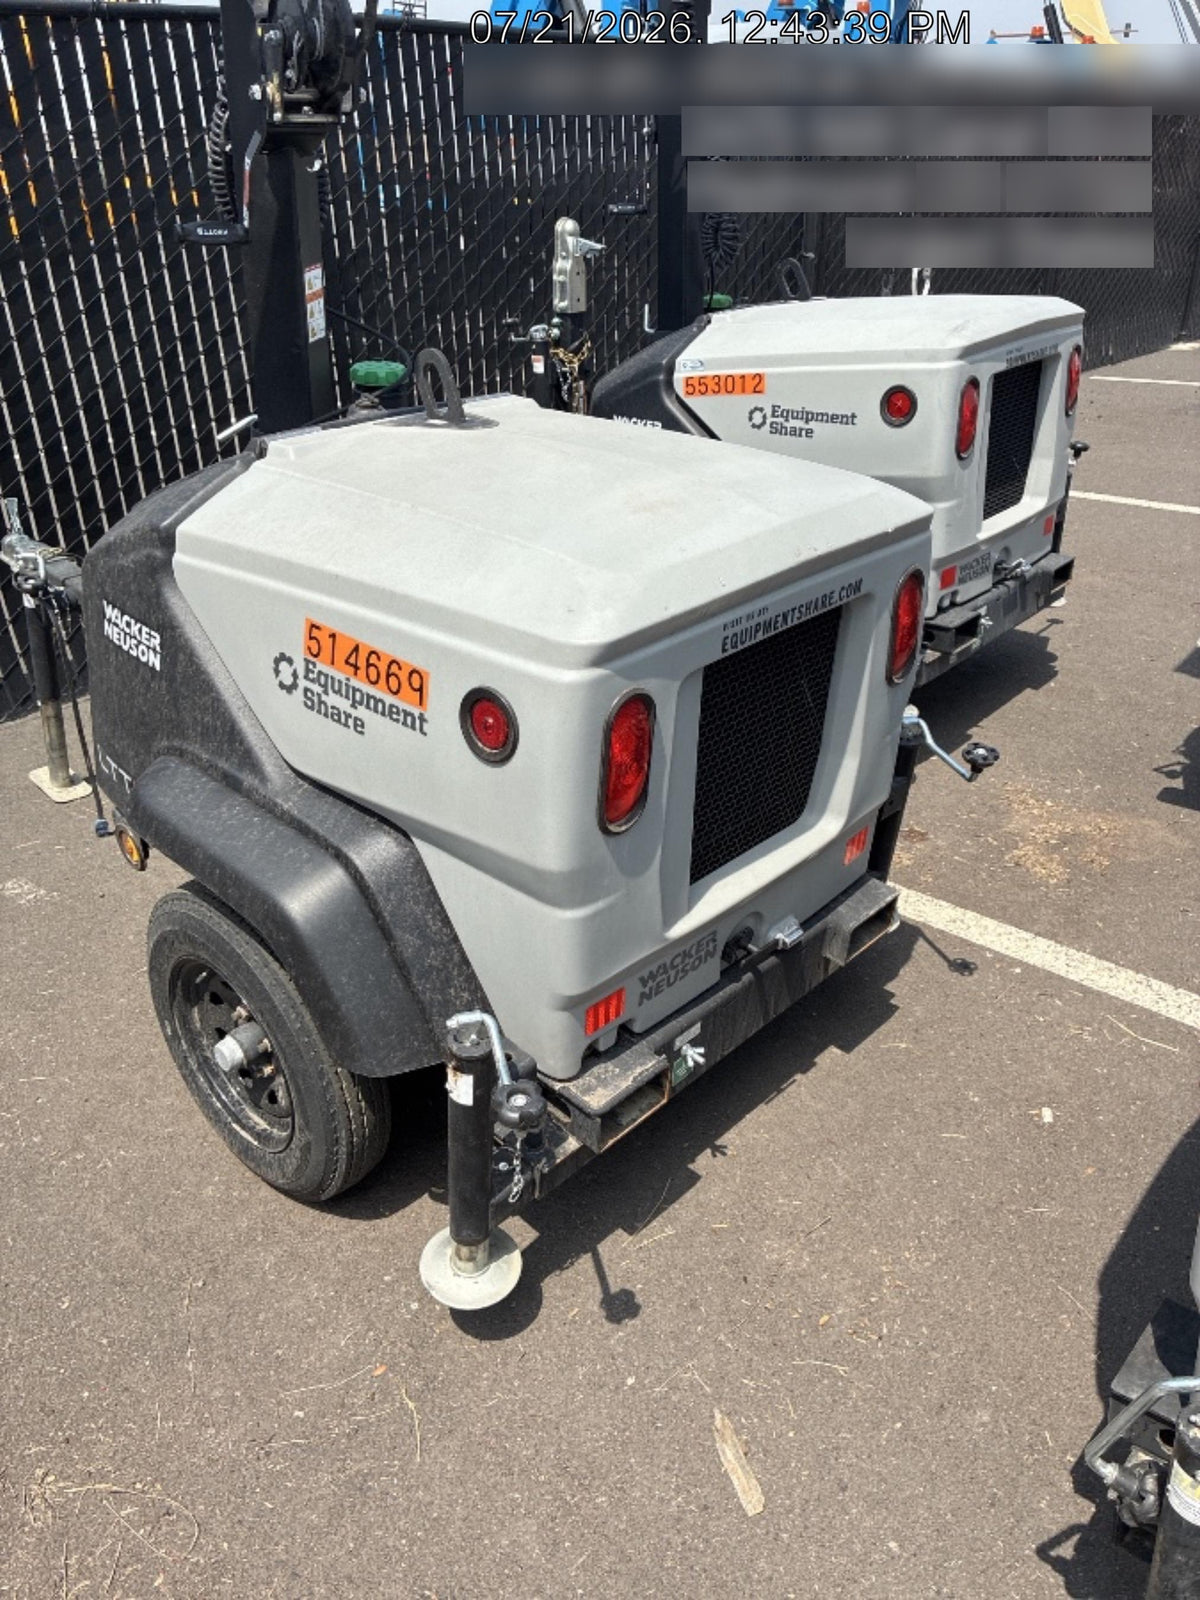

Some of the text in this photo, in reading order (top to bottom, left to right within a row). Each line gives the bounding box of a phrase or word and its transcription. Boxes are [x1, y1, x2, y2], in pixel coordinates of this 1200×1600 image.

[685, 373, 764, 396] 553012
[769, 421, 814, 438] Share
[771, 405, 857, 425] Equipment
[102, 599, 162, 653] WACKER
[721, 577, 863, 653] EQUIPMENTSHARE.COM
[104, 618, 161, 671] NEUSON
[306, 622, 424, 707] 514669
[302, 657, 429, 737] Equipment
[302, 687, 366, 736] Share
[638, 929, 718, 989] WACKER
[638, 943, 718, 1007] NEUSON
